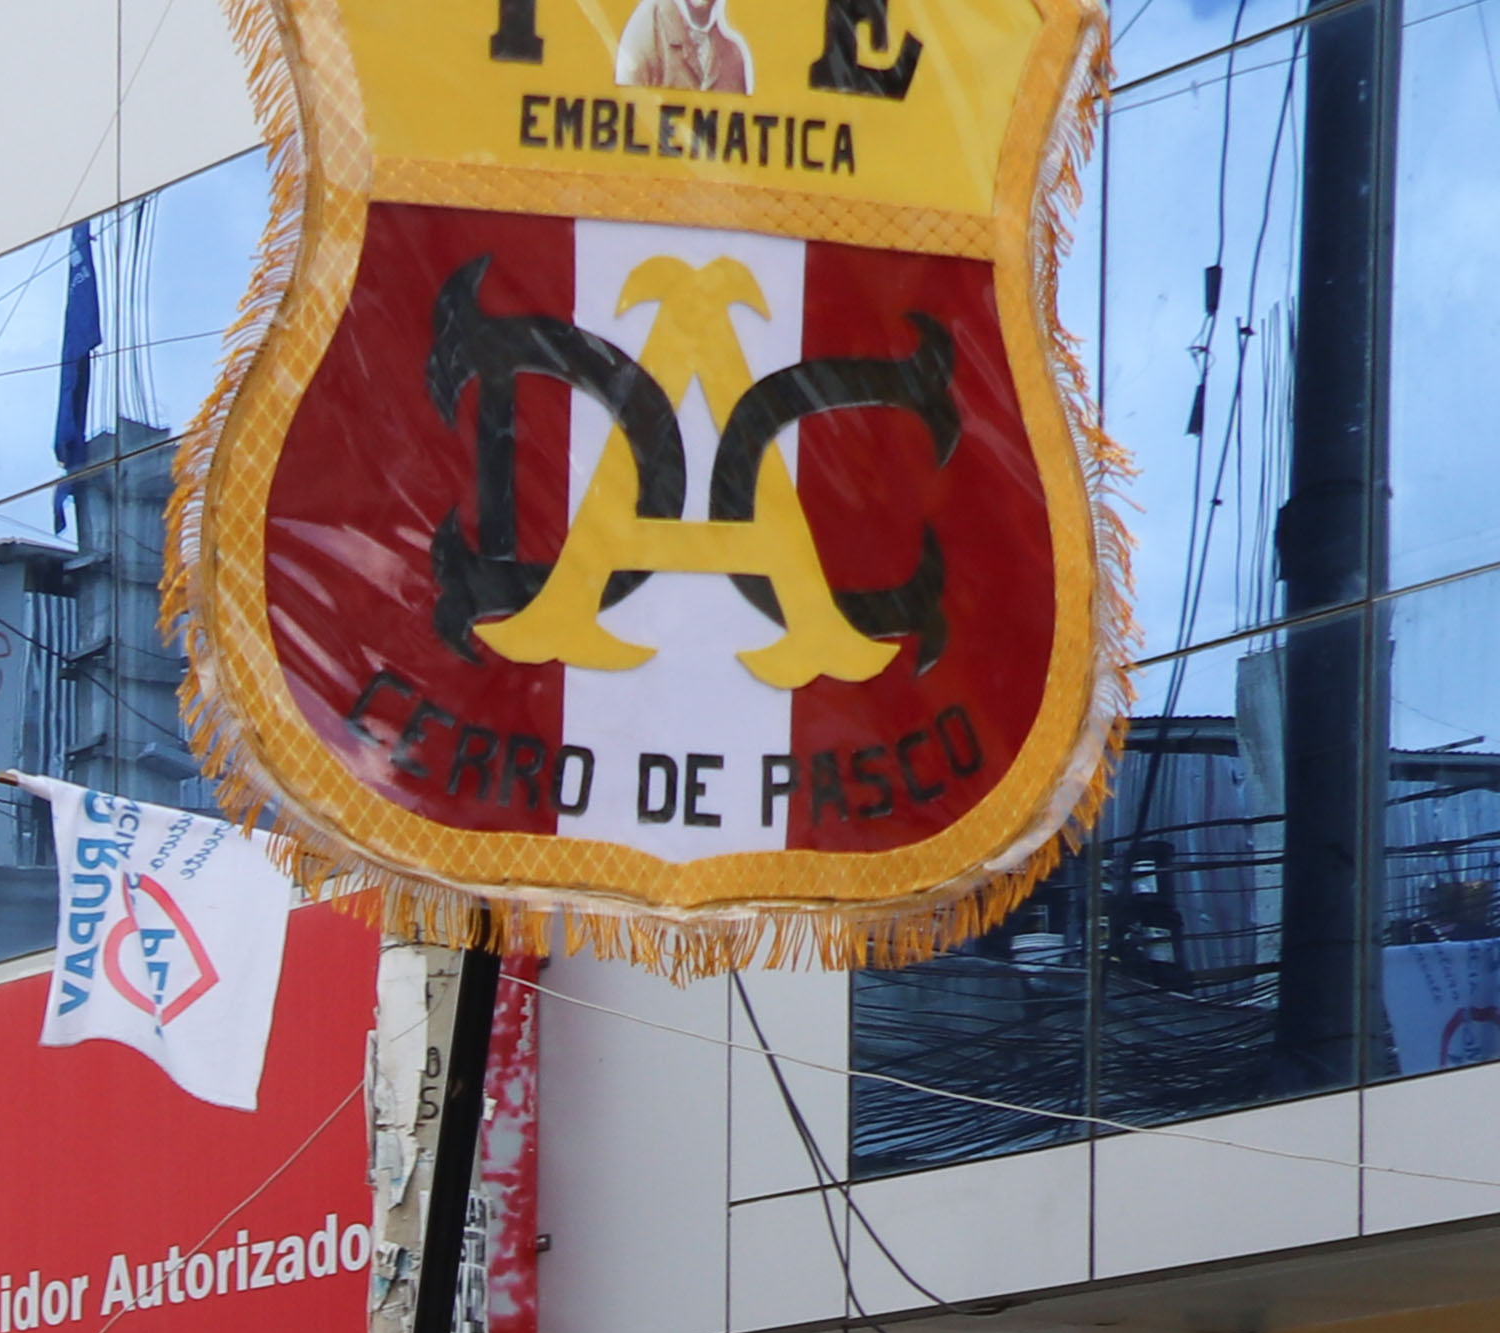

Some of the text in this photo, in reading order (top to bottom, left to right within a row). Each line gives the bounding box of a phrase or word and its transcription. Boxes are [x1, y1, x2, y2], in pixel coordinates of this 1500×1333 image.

[520, 93, 856, 175] EMBLEMATICA
[345, 669, 986, 829] CERRO DE PASCO
[100, 1213, 373, 1316] Autorizado
